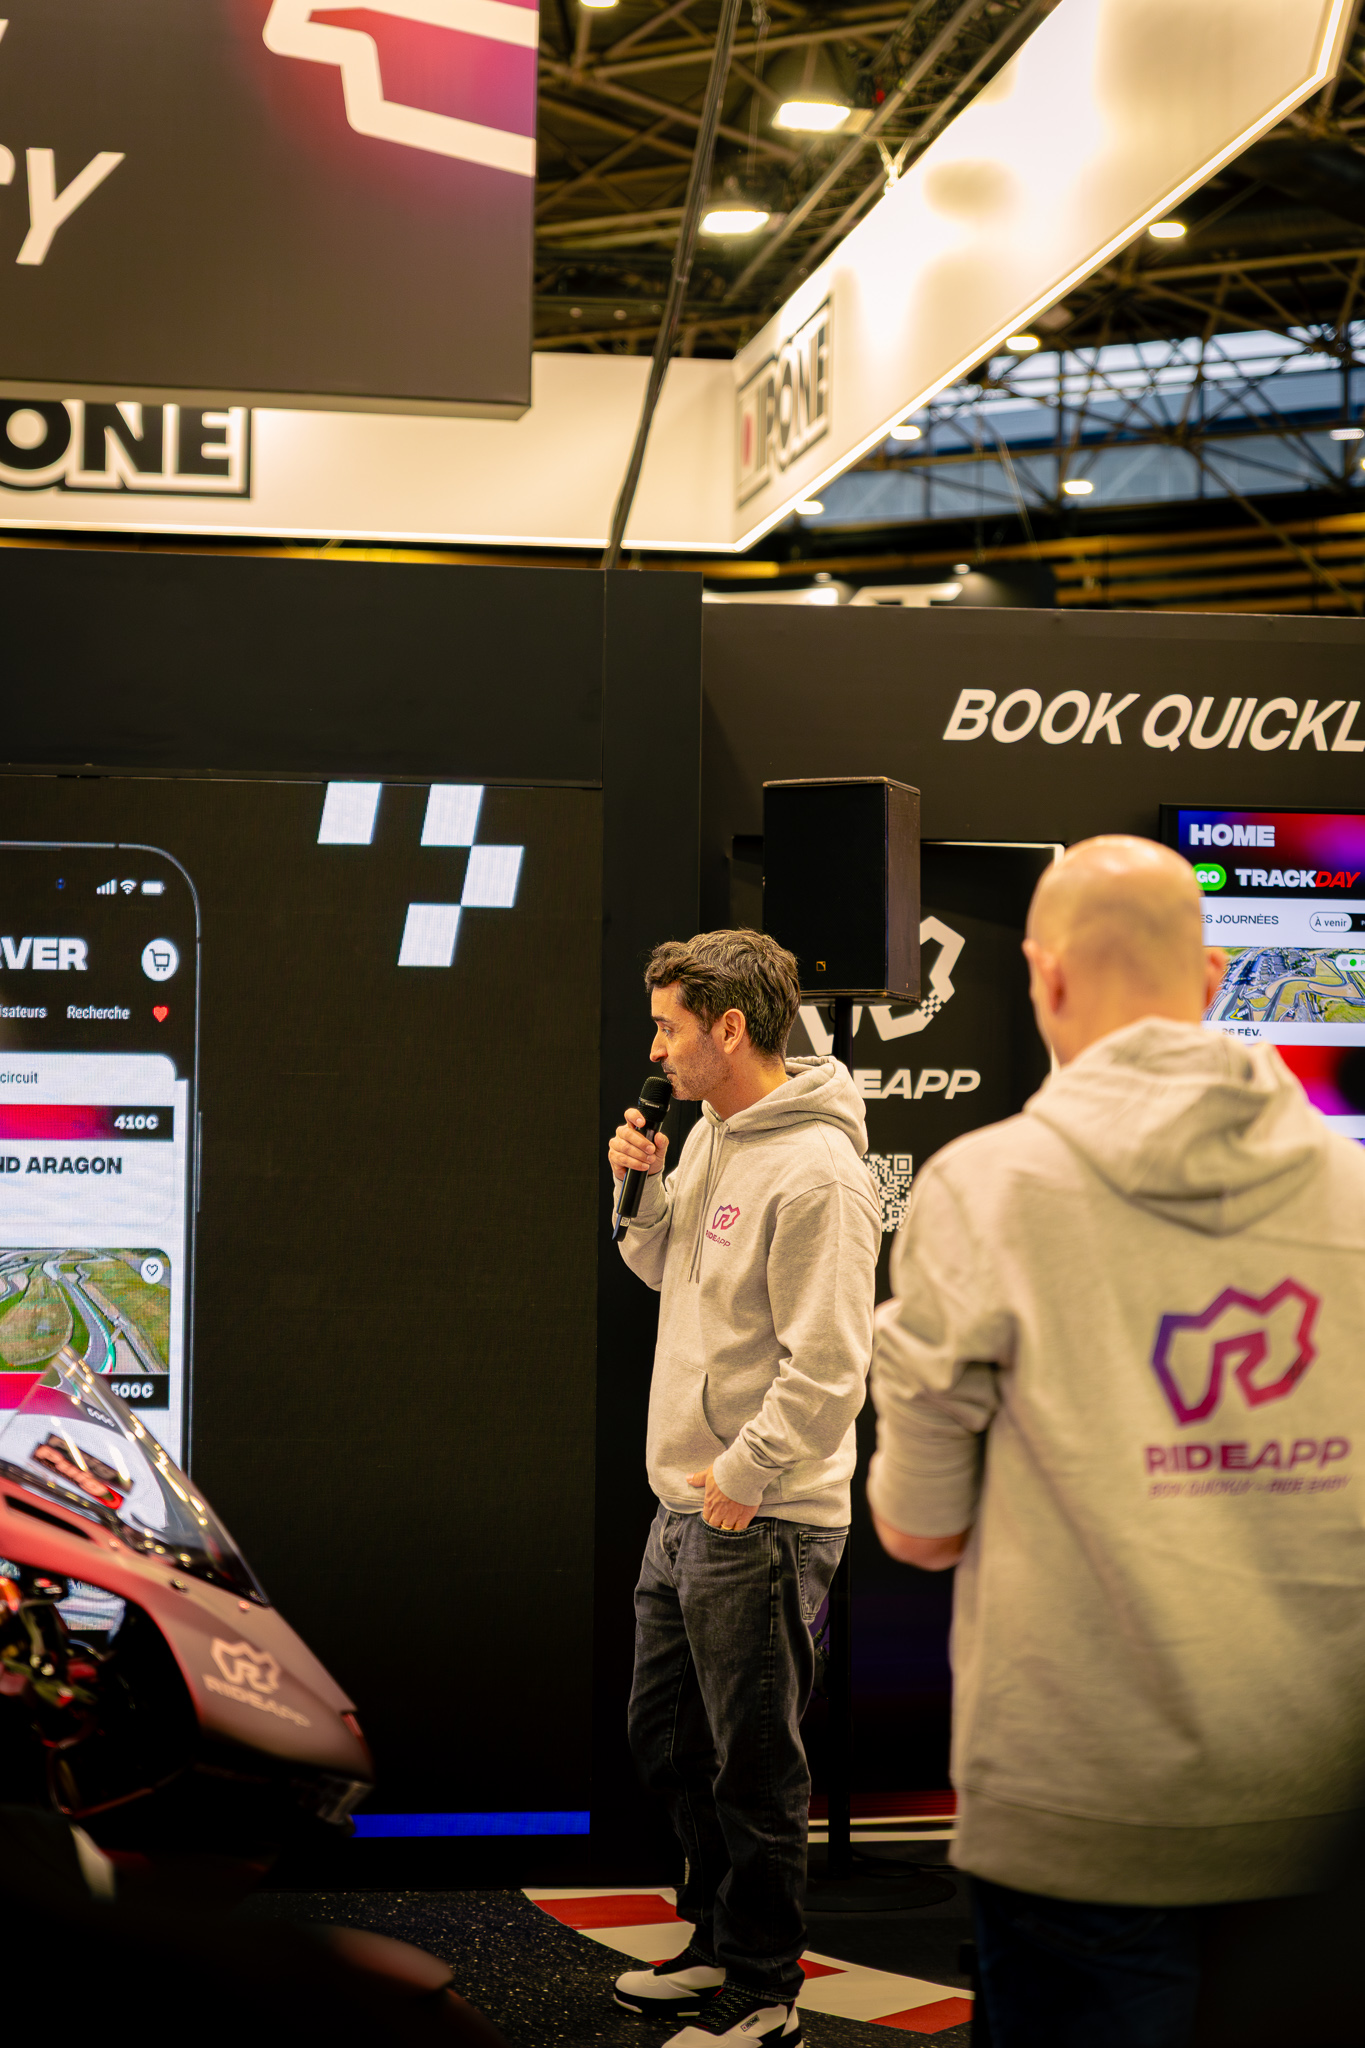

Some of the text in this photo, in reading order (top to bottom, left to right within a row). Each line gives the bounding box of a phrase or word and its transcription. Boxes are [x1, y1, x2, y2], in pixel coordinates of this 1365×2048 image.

[942, 688, 1365, 752] BOOK QUICKL
[1189, 823, 1275, 847] HOME
[1196, 868, 1361, 888] GO TRACKDAY
[1215, 913, 1279, 925] JOURNÉES
[1324, 918, 1347, 927] venir
[0, 936, 88, 970] VER
[66, 1004, 131, 1020] Recherche
[1237, 1026, 1262, 1037] FÉV.
[0, 1070, 38, 1084] circuit
[25, 1156, 122, 1174] ARAGON
[1145, 1437, 1351, 1475] RIDEAPP
